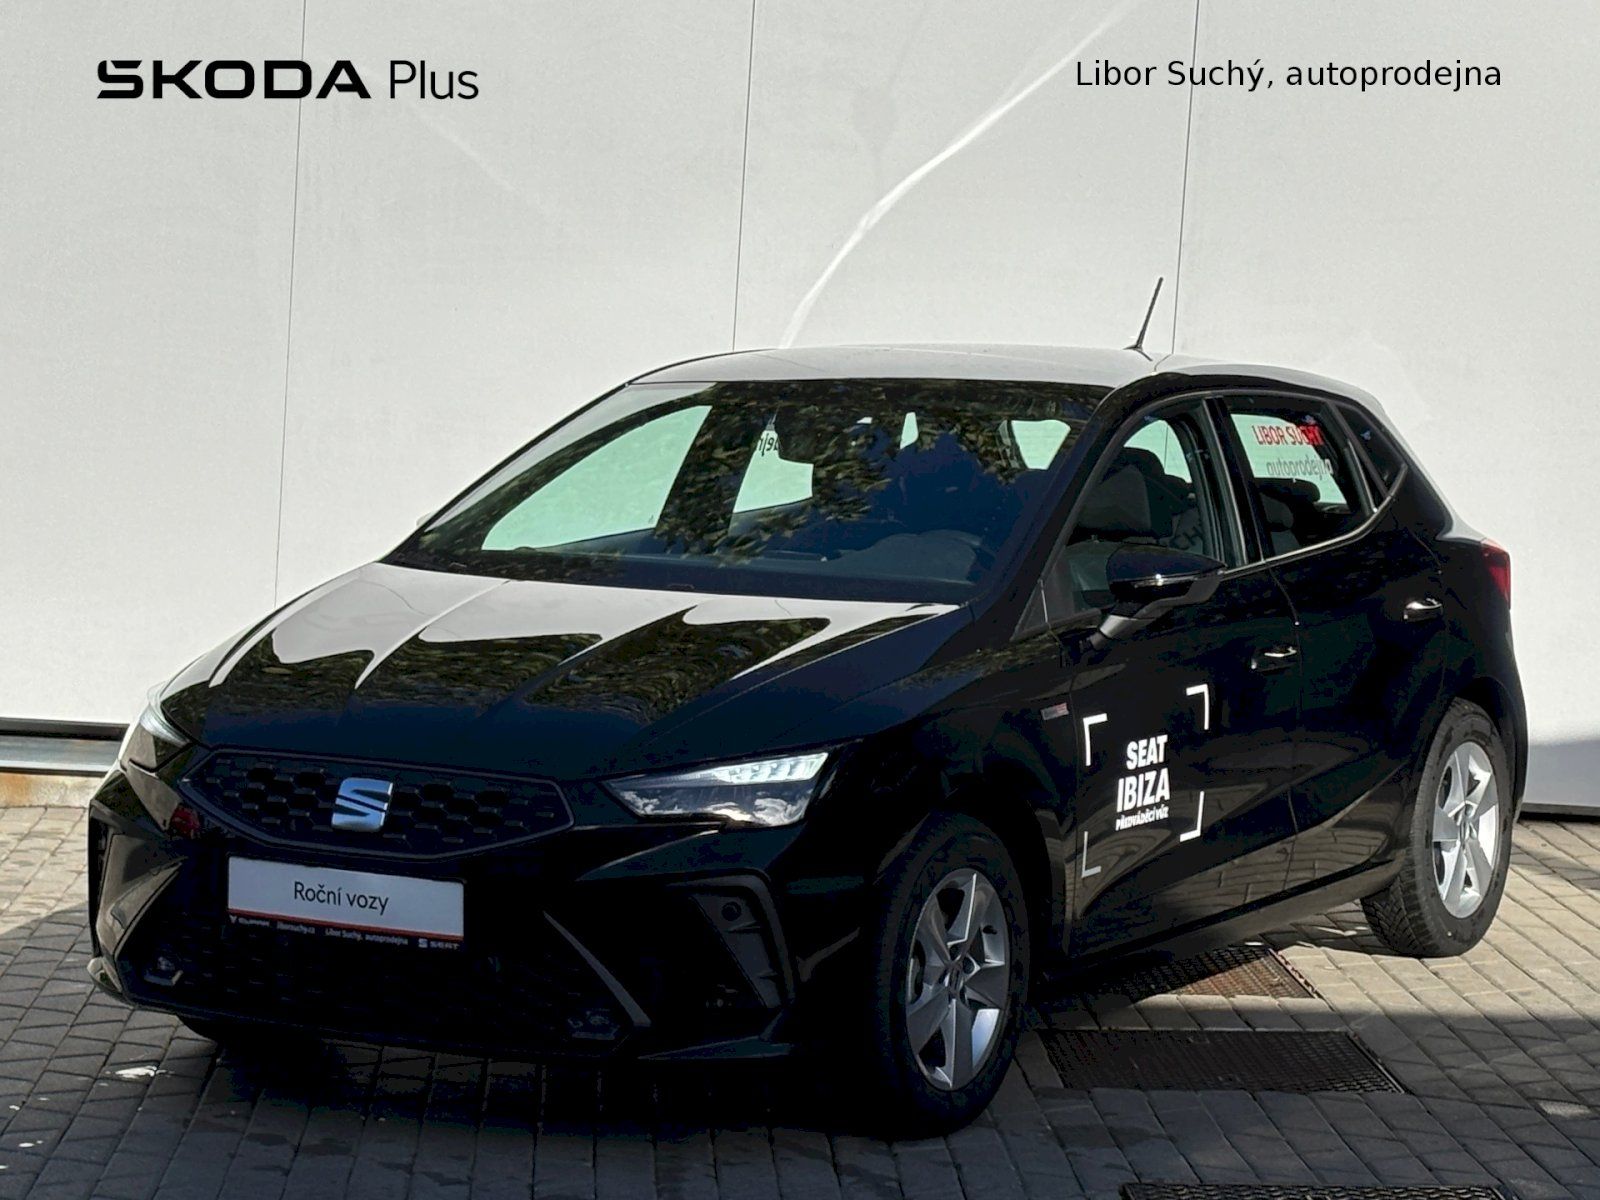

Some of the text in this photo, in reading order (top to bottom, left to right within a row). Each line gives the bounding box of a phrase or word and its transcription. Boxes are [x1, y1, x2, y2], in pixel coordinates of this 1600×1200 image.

[1252, 425, 1288, 445] LIBOR
[1126, 734, 1168, 770] SEAT
[1116, 767, 1171, 813] IBIZA
[293, 880, 389, 916] Roční vozy
